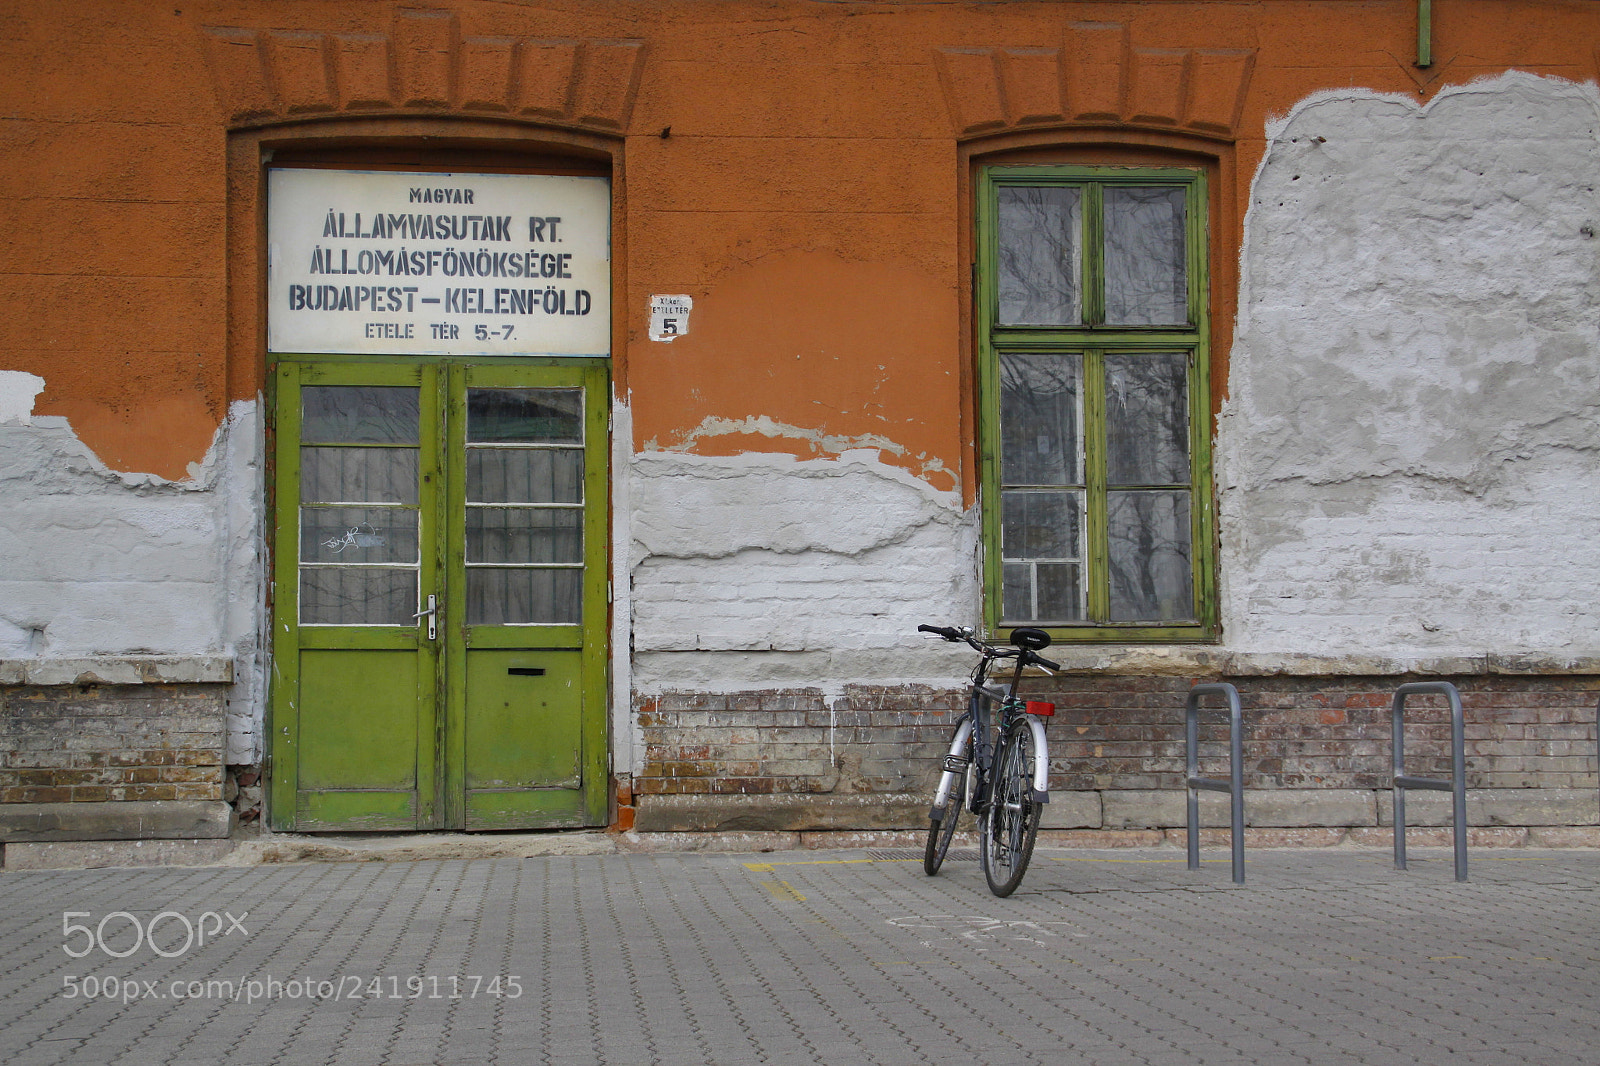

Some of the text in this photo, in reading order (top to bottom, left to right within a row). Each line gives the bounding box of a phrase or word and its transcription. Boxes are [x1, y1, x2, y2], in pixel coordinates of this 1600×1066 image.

[410, 188, 474, 204] MAGYAR
[323, 208, 562, 242] ÁLLAMVASUTAK RT.
[365, 323, 414, 339] ETELE
[431, 321, 459, 339] TÉR
[664, 319, 677, 334] 5
